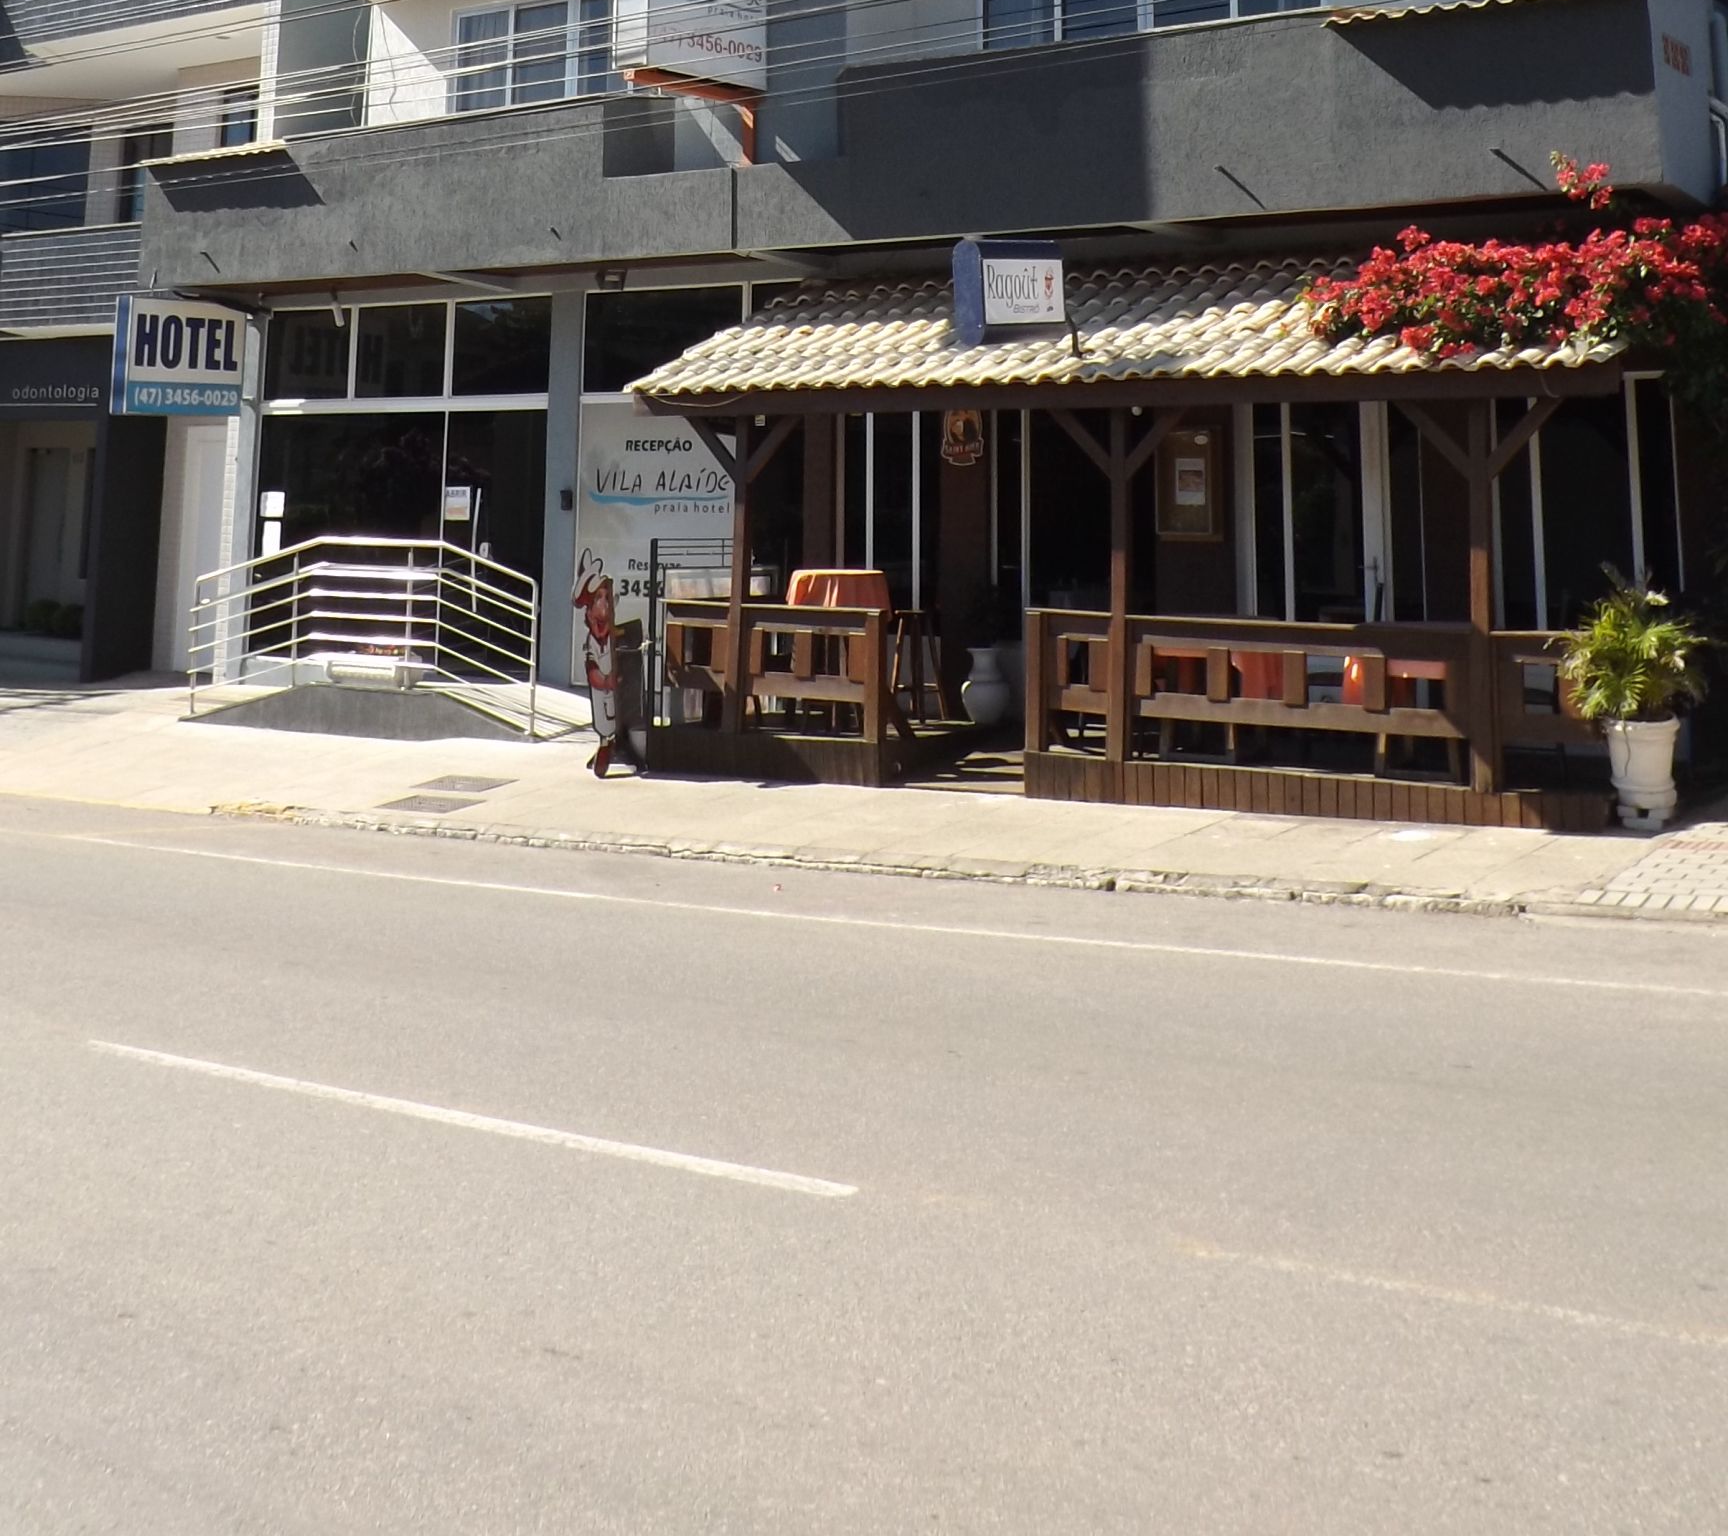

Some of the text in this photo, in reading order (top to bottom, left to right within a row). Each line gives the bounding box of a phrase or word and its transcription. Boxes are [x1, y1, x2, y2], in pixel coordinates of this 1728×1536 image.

[986, 264, 1040, 309] Ragoût
[133, 313, 239, 373] HOTEL
[12, 383, 100, 402] odontologia
[133, 386, 239, 408] (47) 3456-0029
[625, 437, 692, 454] RECEPÇÃO
[596, 467, 730, 494] VILA ALAÍDE
[654, 501, 731, 514] praia hotel
